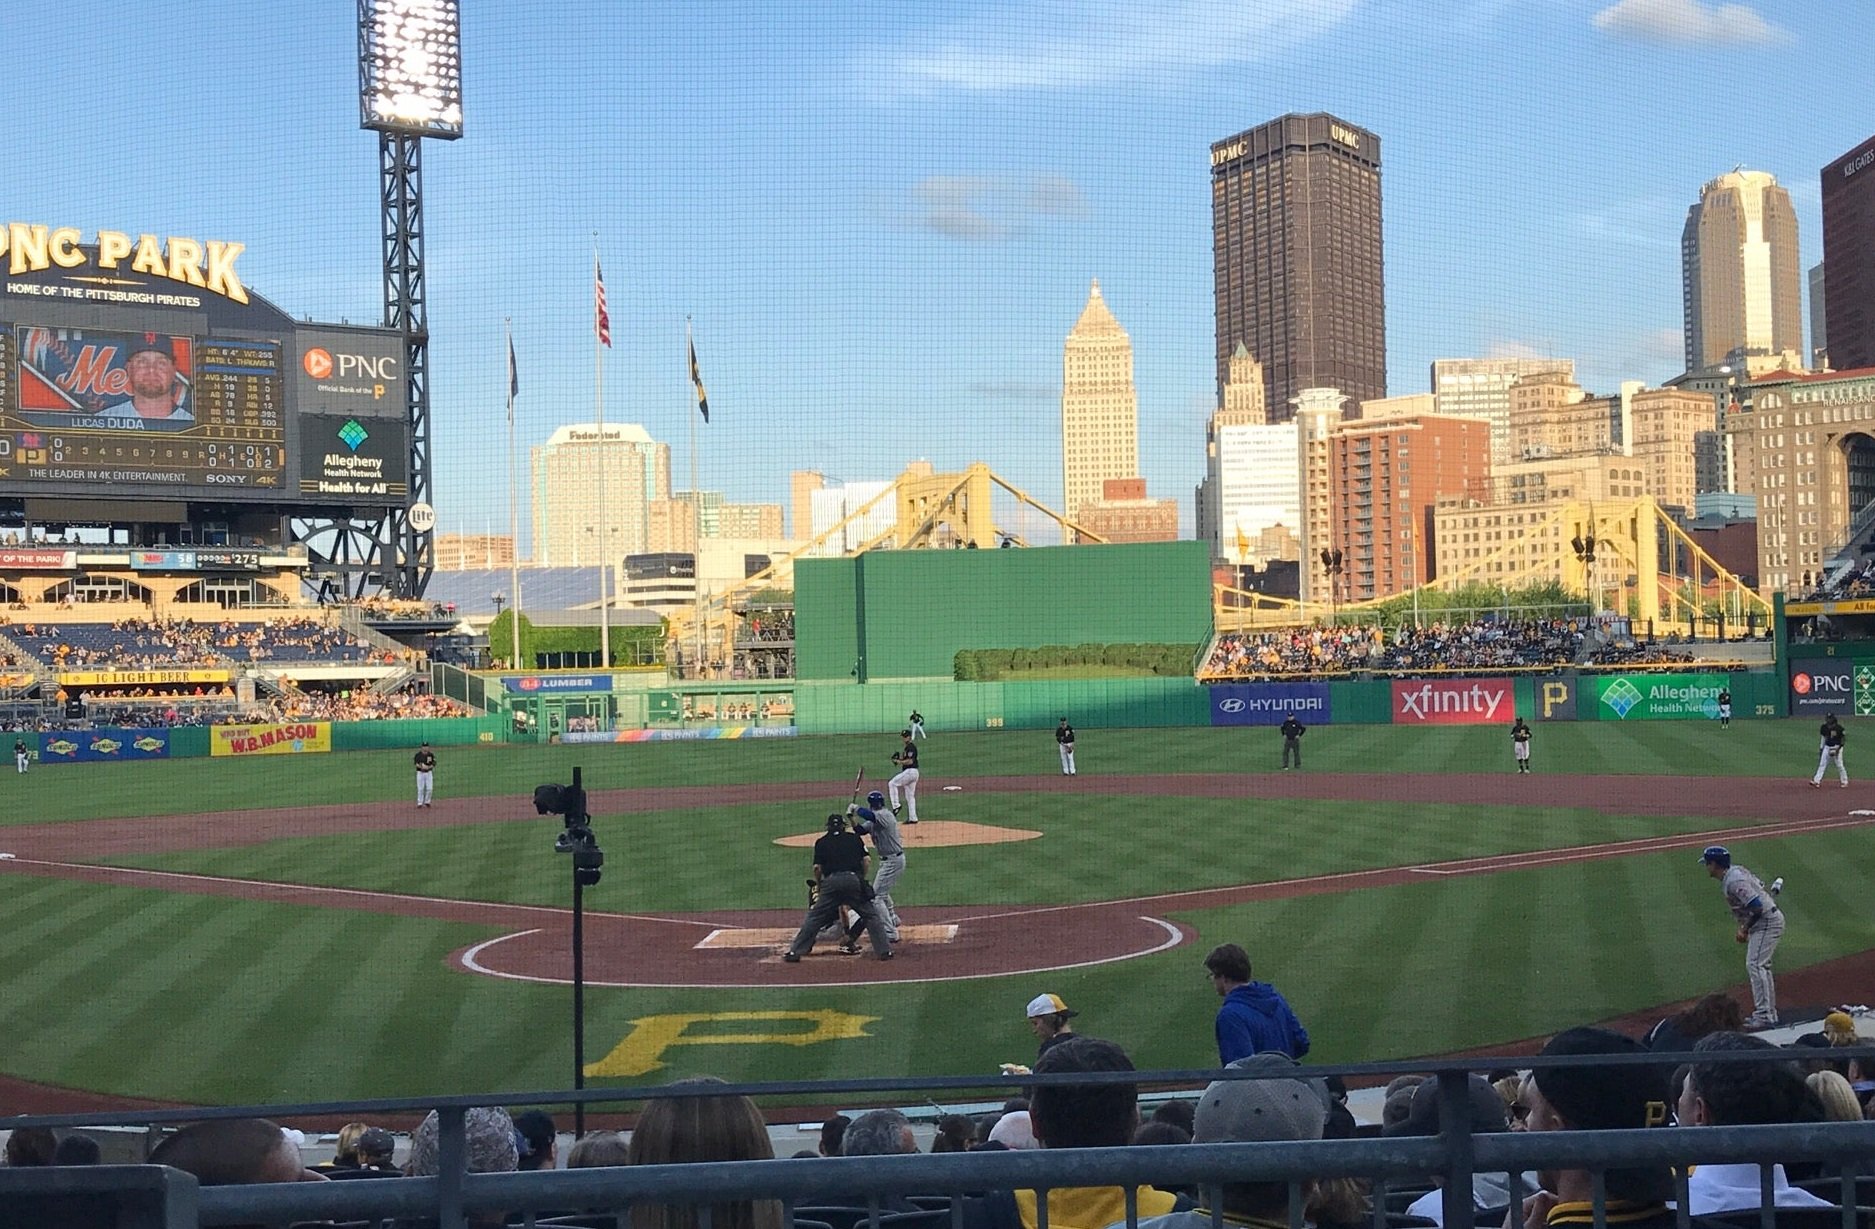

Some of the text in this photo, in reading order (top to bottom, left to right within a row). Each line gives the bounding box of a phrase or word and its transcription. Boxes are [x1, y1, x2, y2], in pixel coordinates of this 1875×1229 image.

[1331, 124, 1360, 148] UPMC
[1211, 141, 1248, 166] UPMC
[1856, 149, 1874, 170] GATES
[0, 223, 248, 305] NC PARK
[7, 283, 200, 307] HOME OF THE PITTSBURGH PIRATES
[55, 345, 134, 396] Me
[336, 354, 397, 380] PNC
[374, 384, 385, 400] P
[72, 418, 144, 430] LUCAS DUDA
[54, 438, 270, 456] 0 0 1 0 1
[82, 447, 88, 455] 3
[116, 448, 122, 456] 5
[166, 450, 172, 458] 8
[199, 451, 205, 459] R
[55, 452, 272, 468] 0 0 1 0 2
[324, 454, 383, 469] Allegheny
[0, 468, 10, 476] K
[29, 469, 188, 482] THE LEADER IN 4K ENTERTAINMENT.
[206, 474, 277, 484] SONY 4K
[324, 468, 382, 478] Health Network
[319, 481, 353, 493] Health
[355, 482, 370, 493] for
[412, 510, 432, 524] Lite
[17, 555, 34, 563] THE
[178, 553, 192, 563] 58
[96, 672, 190, 683] IC LIGHT BEER
[543, 679, 592, 687] LUMBER
[1813, 675, 1850, 692] PNC
[1250, 698, 1322, 711] HYUNDAI
[1401, 684, 1505, 720] xfinity
[1542, 681, 1568, 718] P
[1650, 703, 1720, 713] Health Networ
[1755, 705, 1775, 715] 375
[986, 718, 1004, 728] 399
[480, 732, 494, 741] 410
[582, 1008, 883, 1077] P
[1645, 1100, 1667, 1128] P
